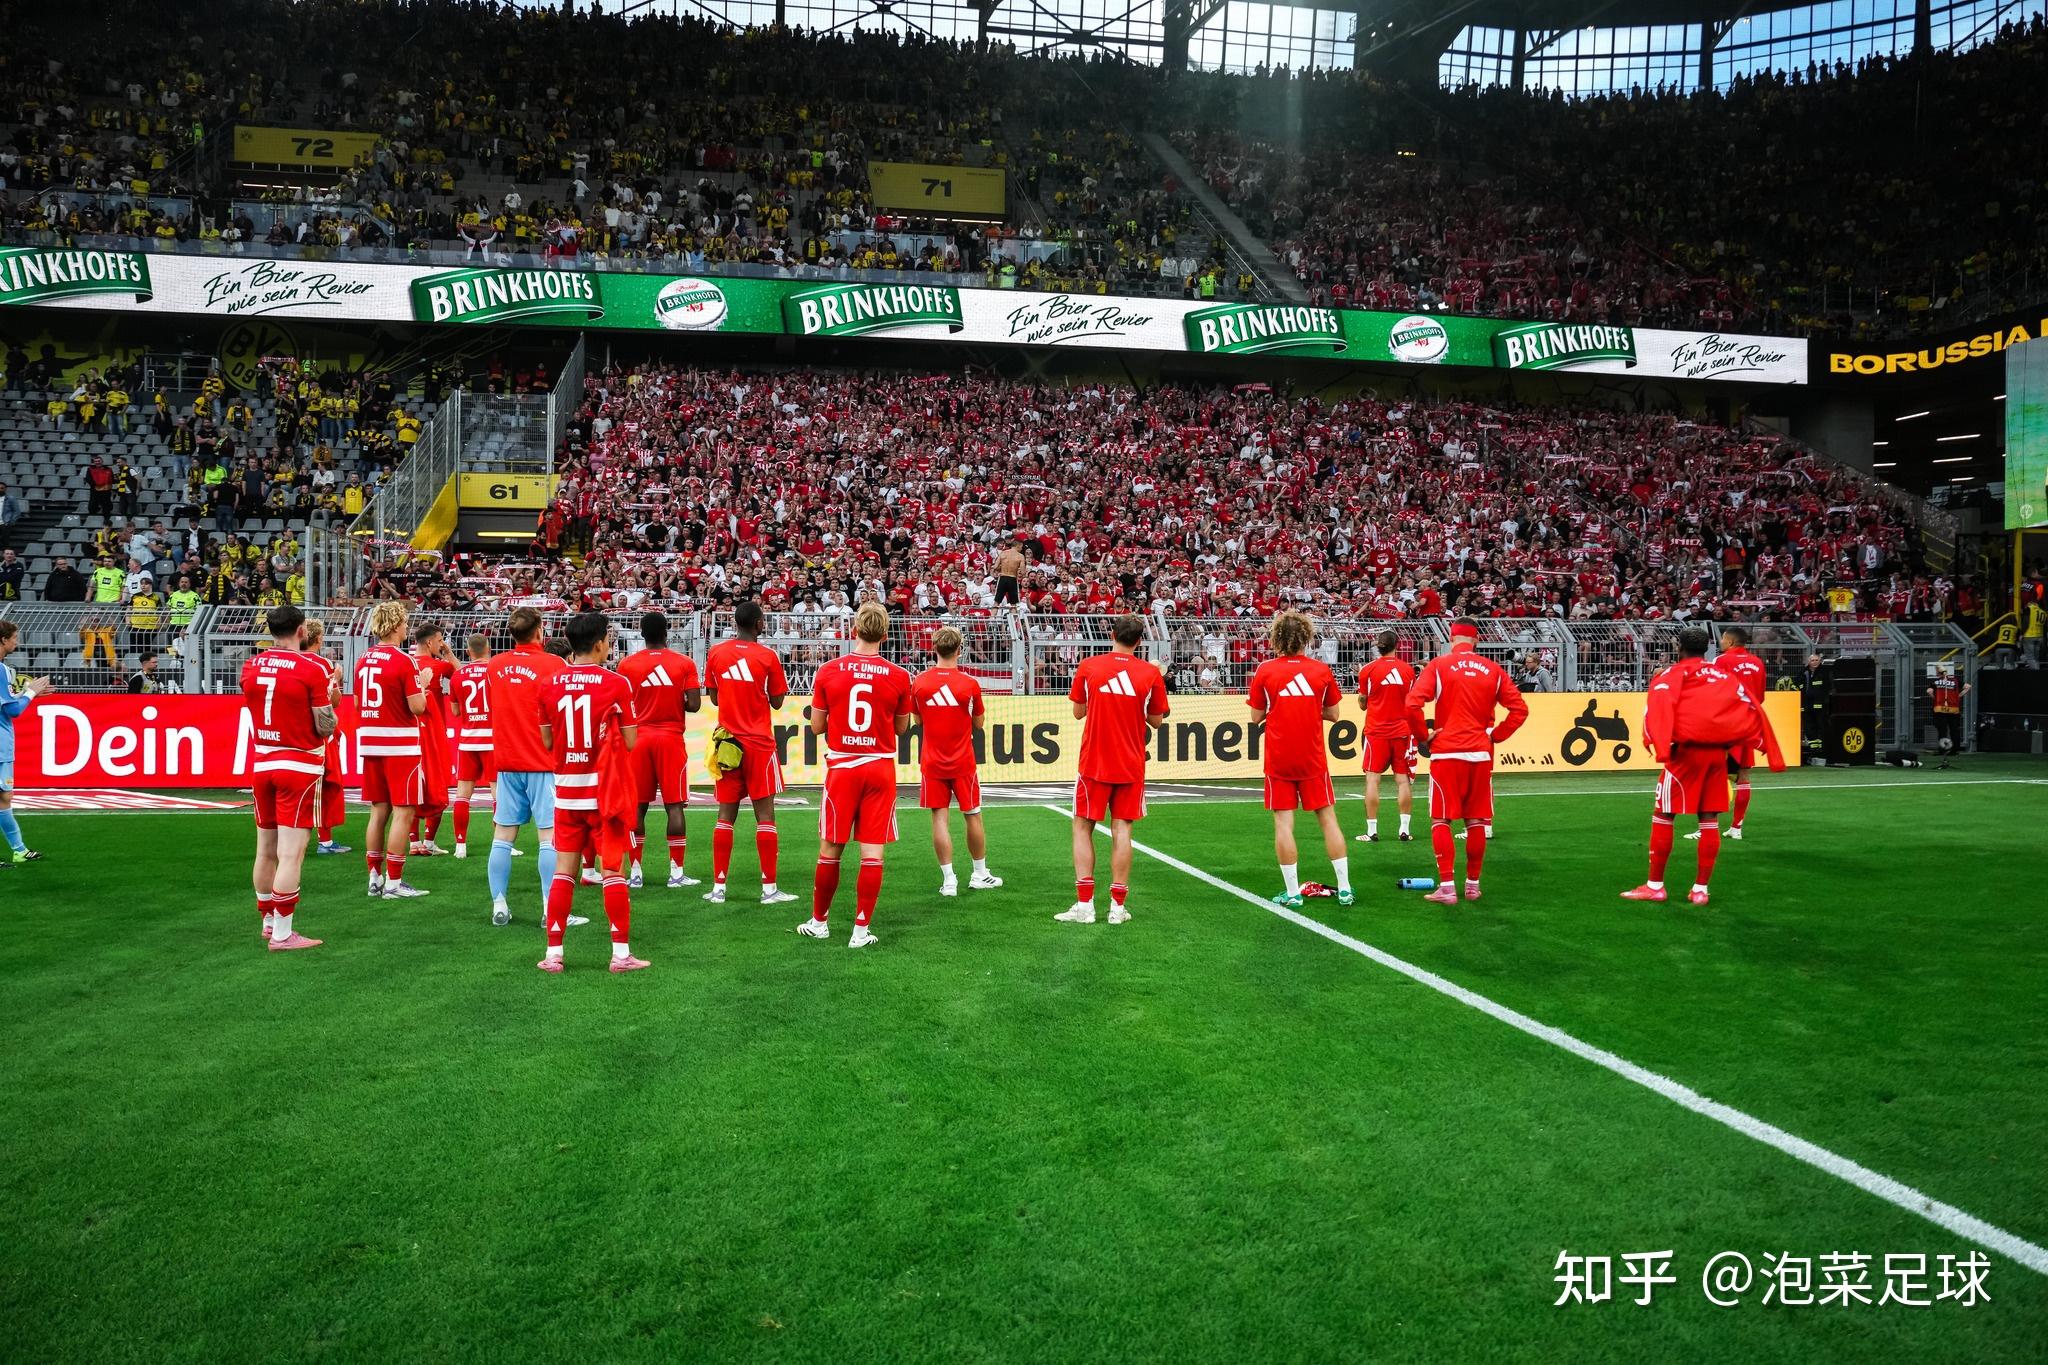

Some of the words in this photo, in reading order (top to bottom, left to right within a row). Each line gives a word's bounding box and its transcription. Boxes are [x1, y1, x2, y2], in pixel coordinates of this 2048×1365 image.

[291, 137, 334, 157] 72
[921, 178, 952, 197] 71
[0, 251, 142, 292] INKHOFF's
[203, 271, 241, 307] Ein
[241, 261, 304, 288] Bier
[227, 294, 257, 313] wie
[261, 286, 299, 303] sein
[301, 273, 375, 299] Revier
[428, 272, 593, 322] BRINKHOFF's
[799, 286, 954, 335] BRINKHOFF's
[1007, 305, 1040, 338] Ein
[1039, 295, 1092, 320] Bier
[1027, 326, 1053, 343] wie
[1058, 317, 1088, 334] sein
[1089, 306, 1154, 331] Revier
[1199, 307, 1338, 352] BRINKHOFF's
[1505, 325, 1630, 368] BRINKHOFF's
[1671, 343, 1697, 372] Ein
[1697, 334, 1738, 355] Bier
[1687, 362, 1708, 378] wie
[1711, 356, 1735, 369] sein
[1737, 345, 1787, 367] Revier
[1830, 325, 2032, 374] BORUSSIA
[489, 484, 519, 500] 61
[1835, 593, 1846, 601] 28
[257, 657, 268, 666] FC
[268, 657, 297, 669] UNION
[371, 652, 392, 661] UNION
[504, 665, 514, 675] FC
[515, 665, 537, 681] Union
[839, 663, 846, 671] 1.
[847, 662, 859, 671] FC
[861, 664, 890, 676] UNION
[1469, 660, 1490, 675] Union
[358, 666, 383, 708] 15
[553, 676, 558, 685] 1.
[560, 674, 570, 683] FC
[571, 673, 603, 684] UNION
[853, 672, 873, 680] BERLIN
[256, 676, 277, 726] 7
[462, 679, 490, 713] 21
[847, 683, 873, 733] 6
[361, 710, 380, 718] ROTHE
[557, 694, 592, 748] 11
[36, 704, 204, 776] Dein
[258, 729, 281, 741] BURKE
[842, 735, 876, 746] KEMLEIN
[1845, 730, 1862, 746] BVB
[565, 752, 589, 764] JEONG
